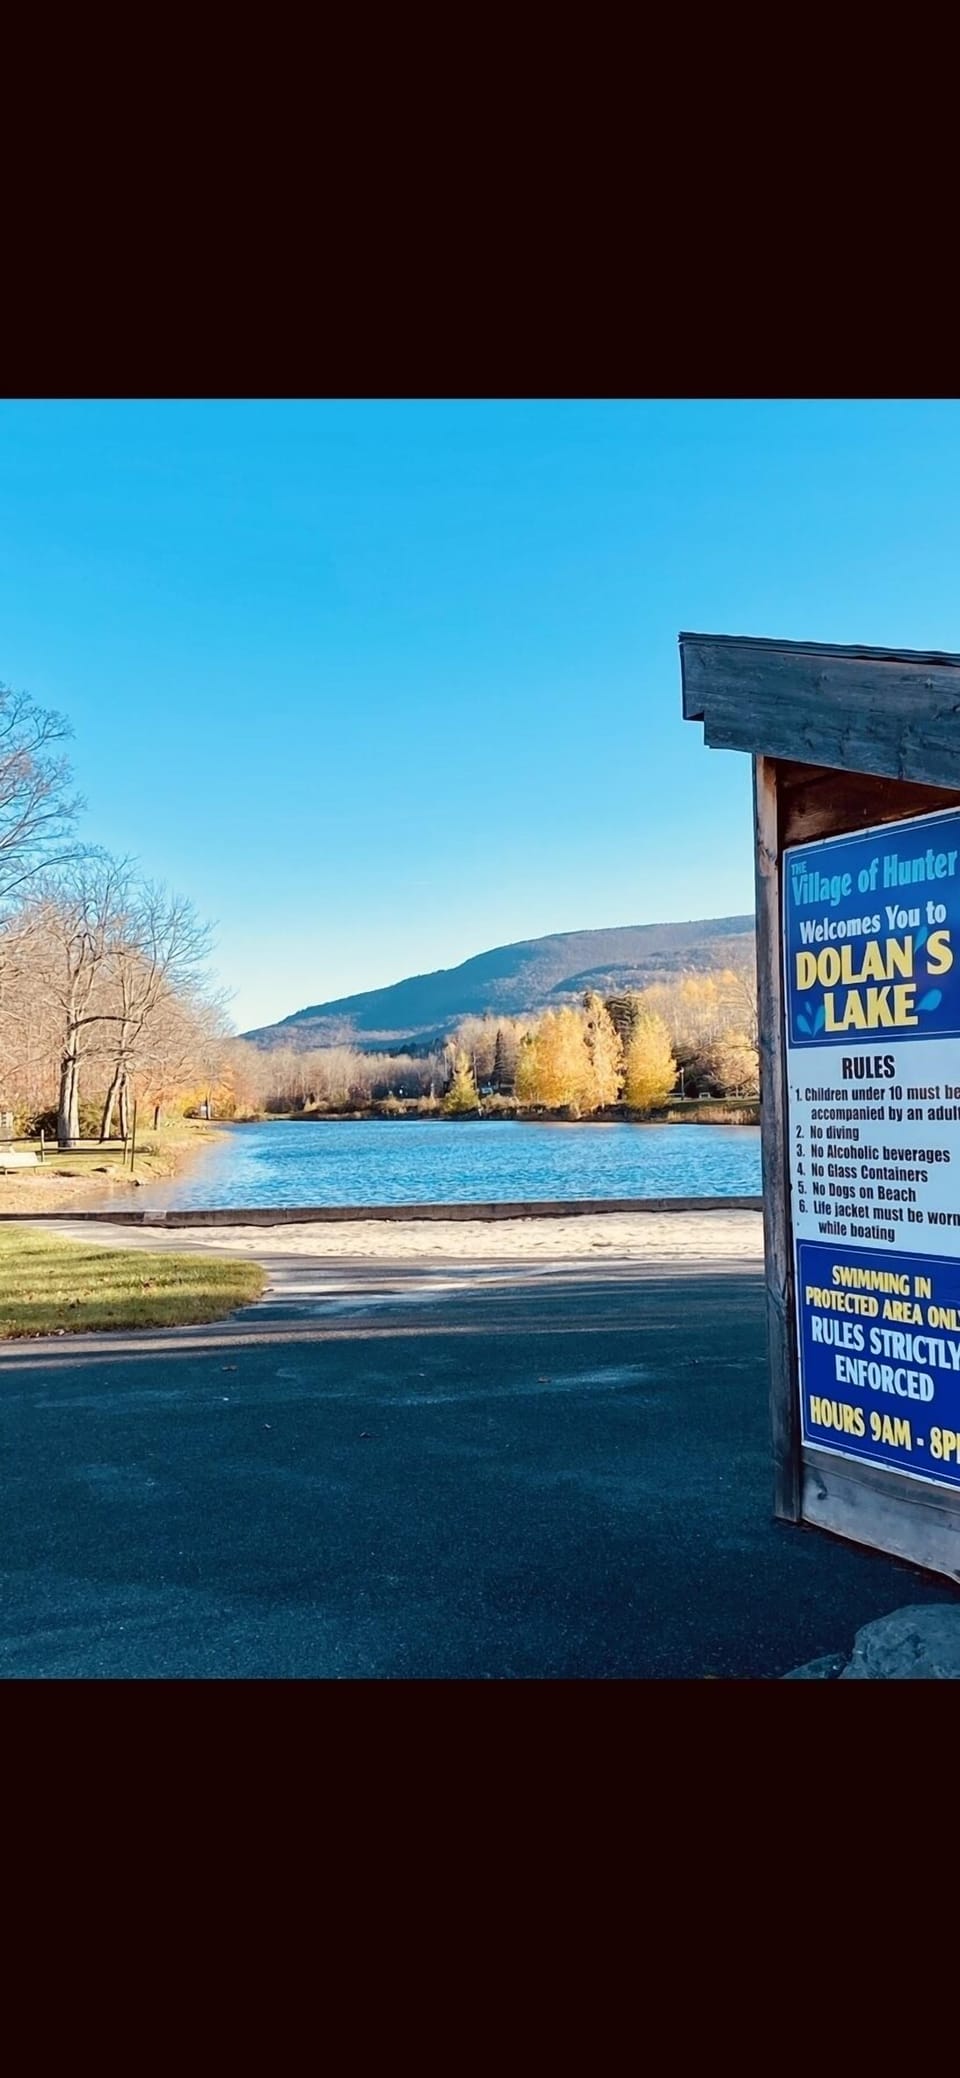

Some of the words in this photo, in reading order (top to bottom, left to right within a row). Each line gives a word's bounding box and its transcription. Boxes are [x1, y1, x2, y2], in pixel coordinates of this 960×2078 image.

[791, 861, 807, 875] THE
[792, 872, 851, 906] Village
[858, 858, 878, 893] of
[883, 849, 957, 888] Hunter
[800, 914, 881, 944] Welcomes
[885, 905, 921, 930] You
[926, 901, 947, 925] to
[824, 984, 918, 1032] LAKE
[842, 1055, 895, 1079] RULES
[805, 1088, 848, 1101] Children
[851, 1087, 885, 1101] under
[888, 1086, 902, 1100] 10
[907, 1085, 940, 1100] must
[945, 1085, 960, 1100] be
[811, 1106, 885, 1122] accompanied
[888, 1106, 903, 1122] by
[907, 1107, 923, 1121] an
[796, 1125, 804, 1139] 2.
[810, 1125, 823, 1139] No
[826, 1126, 859, 1141] diving
[796, 1144, 805, 1158] 3.
[811, 1144, 824, 1158] No
[827, 1145, 880, 1160] Alcoholic
[882, 1146, 951, 1164] beverages
[797, 1163, 806, 1176] 4.
[812, 1163, 825, 1177] No
[827, 1164, 857, 1179] Glass
[861, 1165, 928, 1183] Containers
[798, 1181, 807, 1194] 5.
[813, 1182, 826, 1196] No
[829, 1183, 856, 1201] Dogs
[859, 1187, 874, 1200] on
[878, 1186, 917, 1203] Beach
[799, 1200, 808, 1213] 6.
[813, 1200, 832, 1215] Life
[834, 1202, 870, 1219] jacket
[873, 1207, 904, 1222] must
[907, 1208, 924, 1224] be
[927, 1211, 960, 1227] worn
[818, 1220, 847, 1237] while
[850, 1223, 895, 1243] boating
[832, 1265, 910, 1296] SWIMMING
[914, 1276, 932, 1299] IN
[805, 1286, 878, 1318] PROTECTED
[882, 1300, 923, 1326] AREA
[927, 1306, 960, 1332] ONL
[811, 1315, 865, 1352] RULES
[869, 1327, 960, 1372] STRICTLY
[835, 1354, 935, 1402] ENFORCED
[809, 1395, 866, 1437] HOURS
[869, 1412, 912, 1451] 9AM
[929, 1427, 960, 1464] 8P
